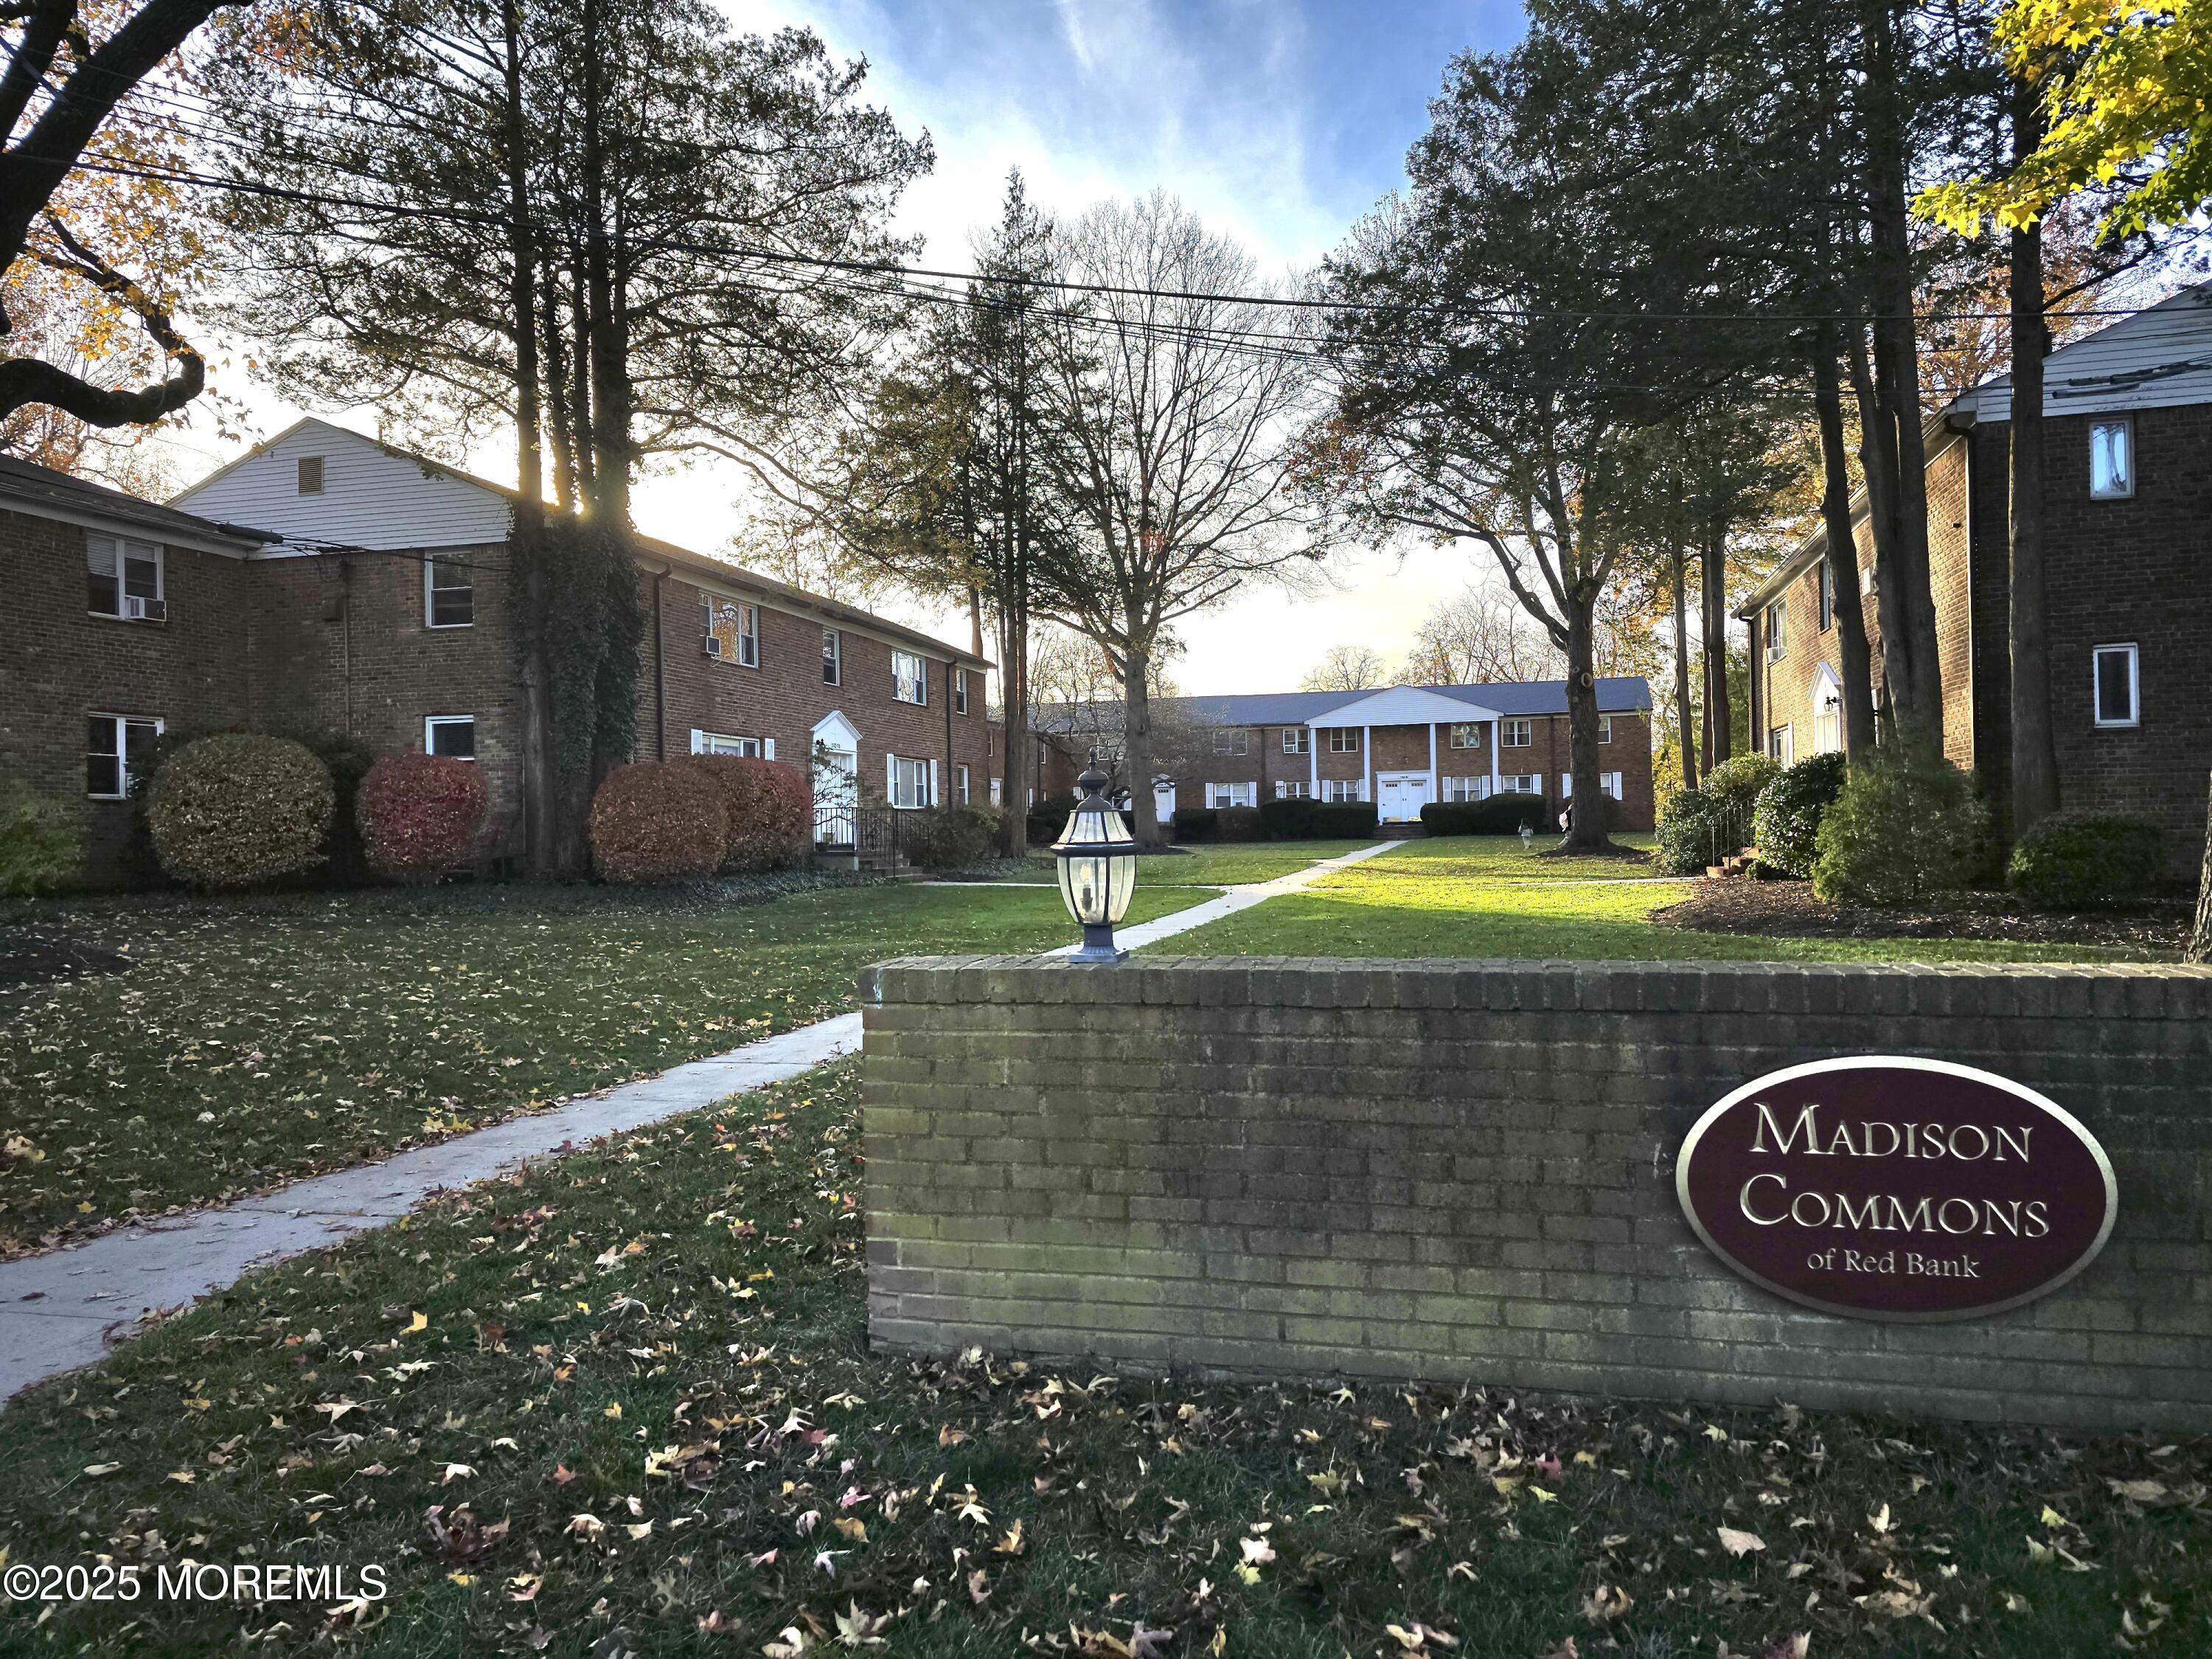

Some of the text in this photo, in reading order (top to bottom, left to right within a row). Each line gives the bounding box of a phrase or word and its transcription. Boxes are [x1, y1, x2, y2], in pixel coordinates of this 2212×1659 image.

[1749, 1102, 2034, 1163] MADISON
[1739, 1173, 2050, 1238] COMMONS
[1806, 1248, 1981, 1278] of Red Bank
